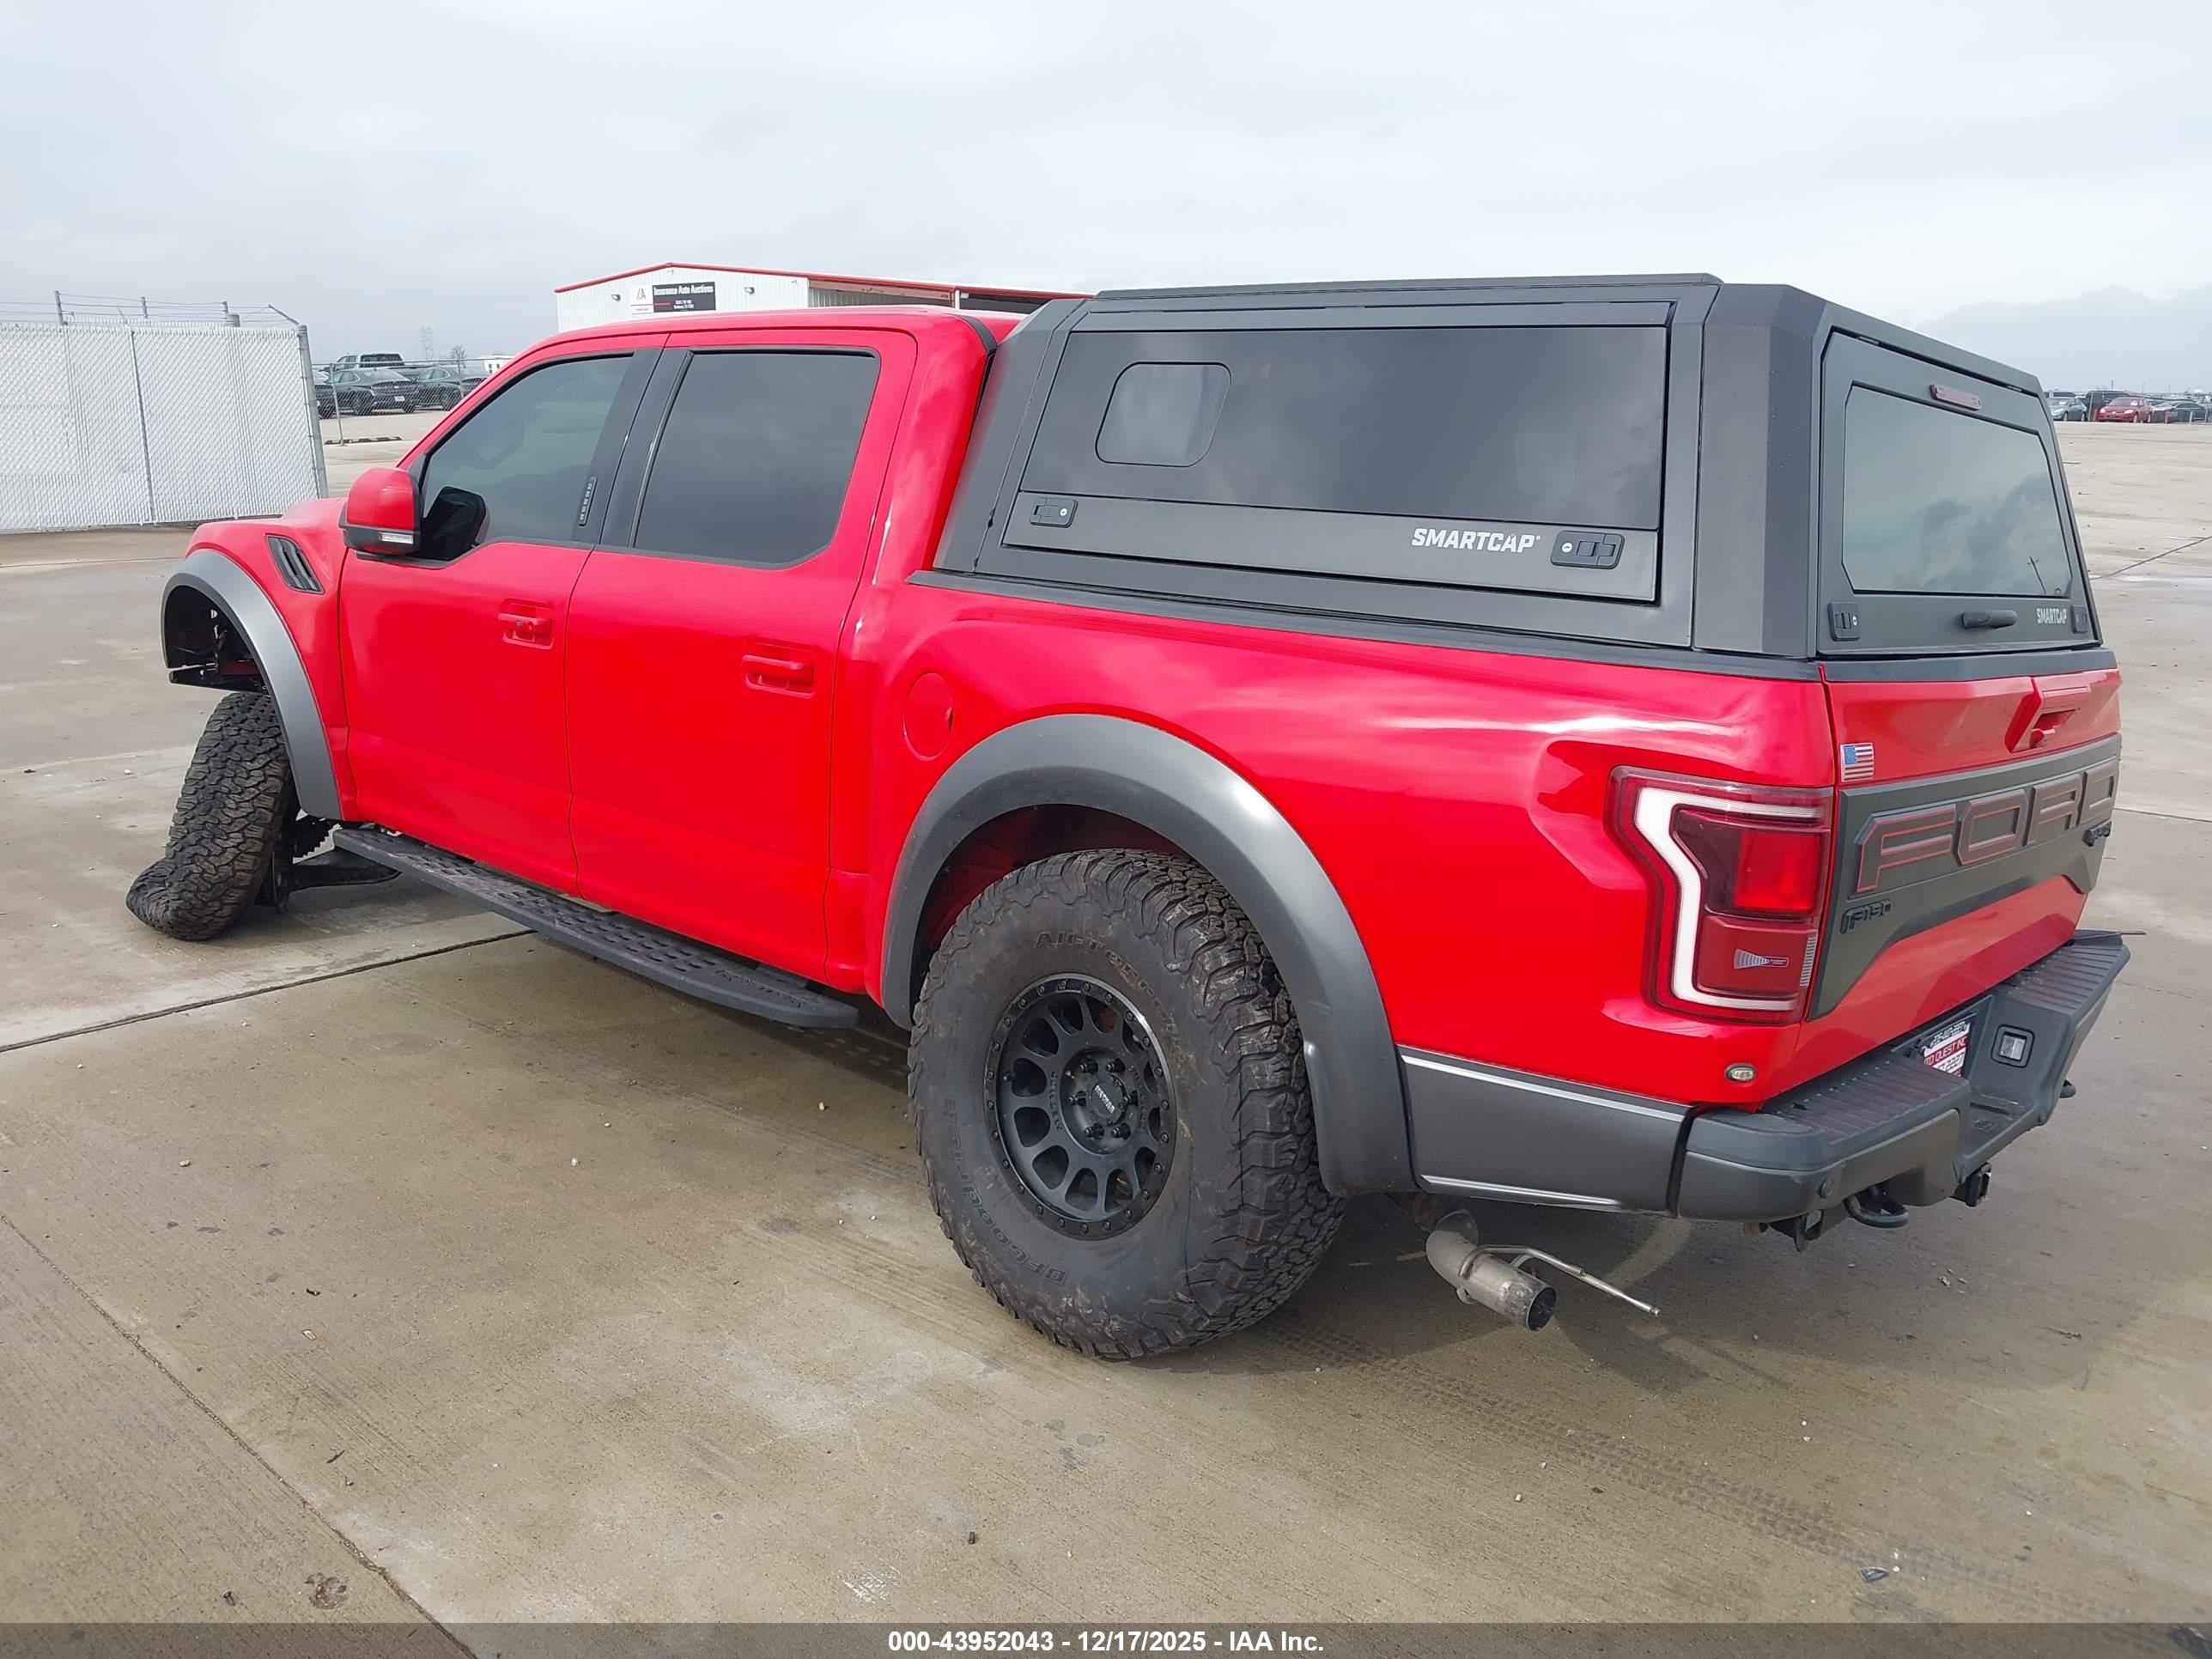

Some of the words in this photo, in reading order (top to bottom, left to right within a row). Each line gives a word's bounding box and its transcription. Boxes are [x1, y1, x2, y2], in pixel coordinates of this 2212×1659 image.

[678, 285, 690, 295] Auto
[690, 284, 714, 294] Auctions
[1412, 528, 1535, 553] SMARTCAP
[2036, 607, 2068, 624] SMARTCAP
[1854, 756, 2118, 893] FORD
